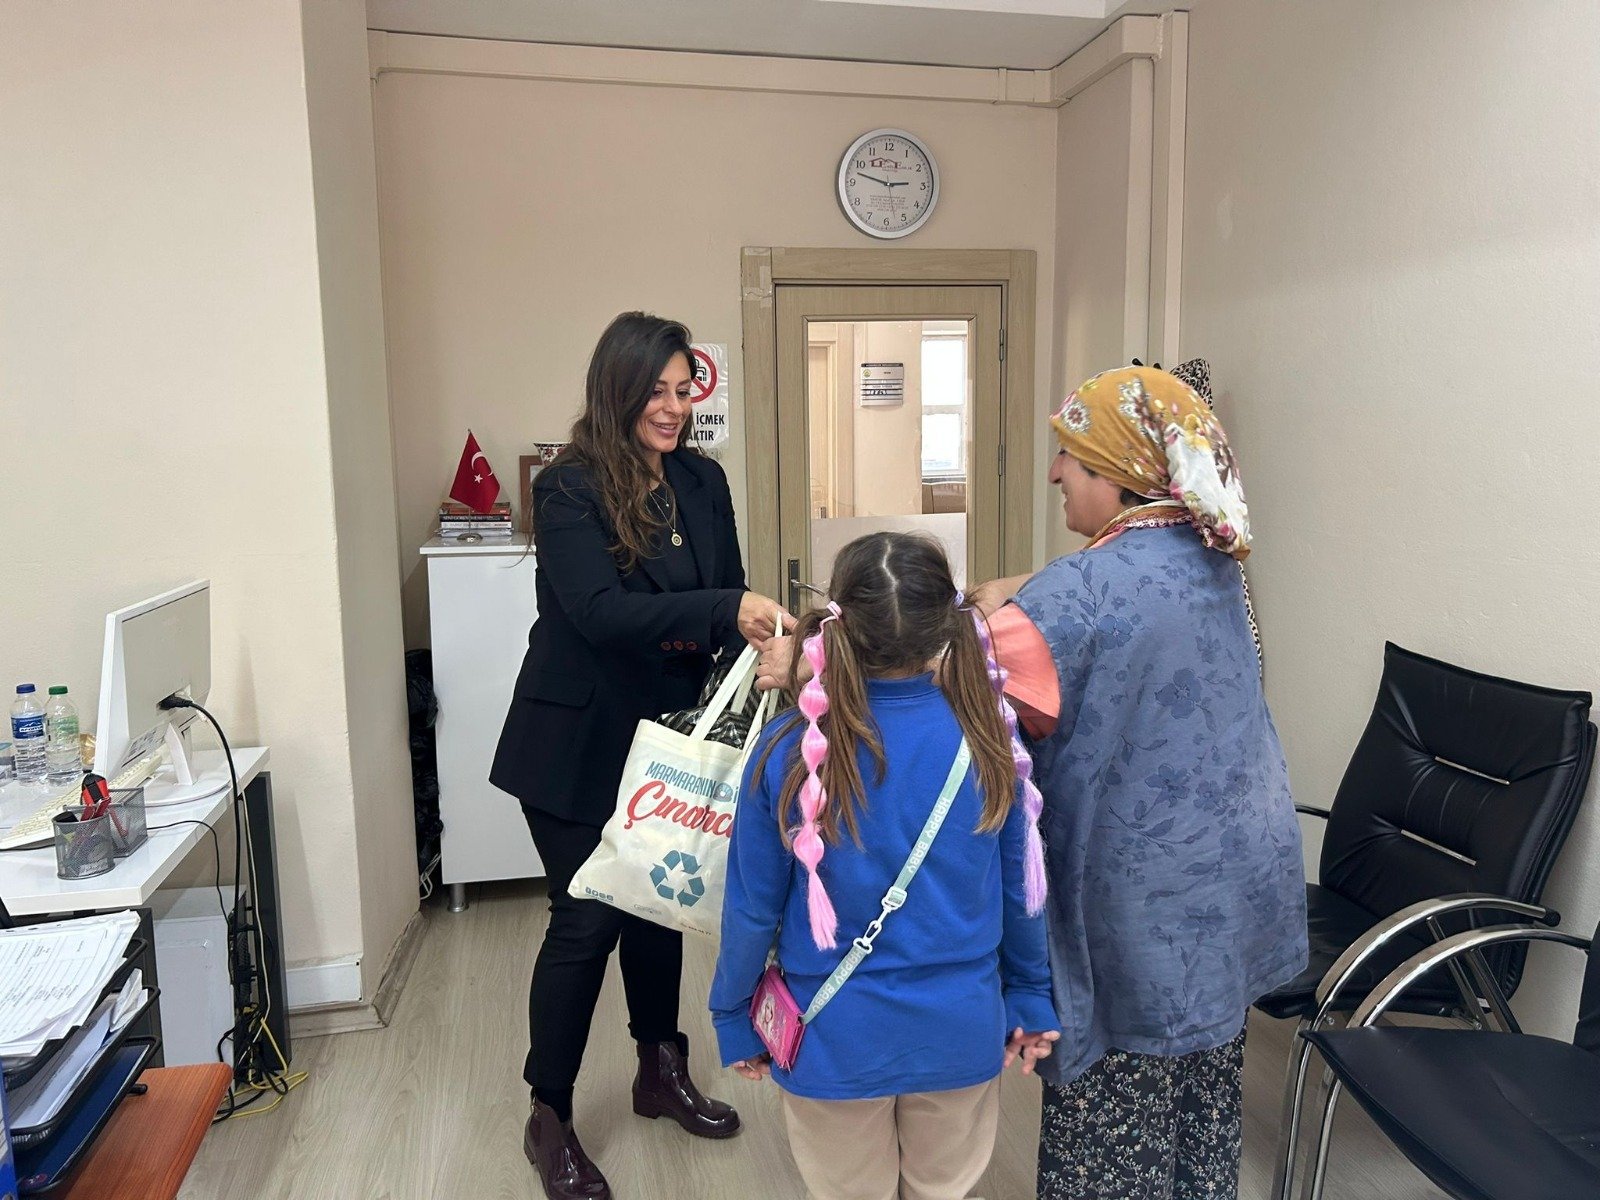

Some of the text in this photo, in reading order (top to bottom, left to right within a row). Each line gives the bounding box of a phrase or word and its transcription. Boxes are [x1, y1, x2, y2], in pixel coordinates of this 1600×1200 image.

[885, 143, 894, 151] 12
[869, 148, 876, 156] 11
[905, 150, 908, 158] 1
[856, 161, 866, 169] 10
[915, 164, 921, 172] 2
[850, 178, 856, 186] 9
[854, 198, 860, 206] 8
[914, 201, 920, 209] 4
[867, 212, 872, 220] 7
[901, 214, 906, 222] 5
[884, 218, 889, 226] 6
[696, 412, 725, 427] İÇMEK
[906, 798, 950, 874] HAPPY BABY
[812, 951, 861, 1014] HAPPY BABY
